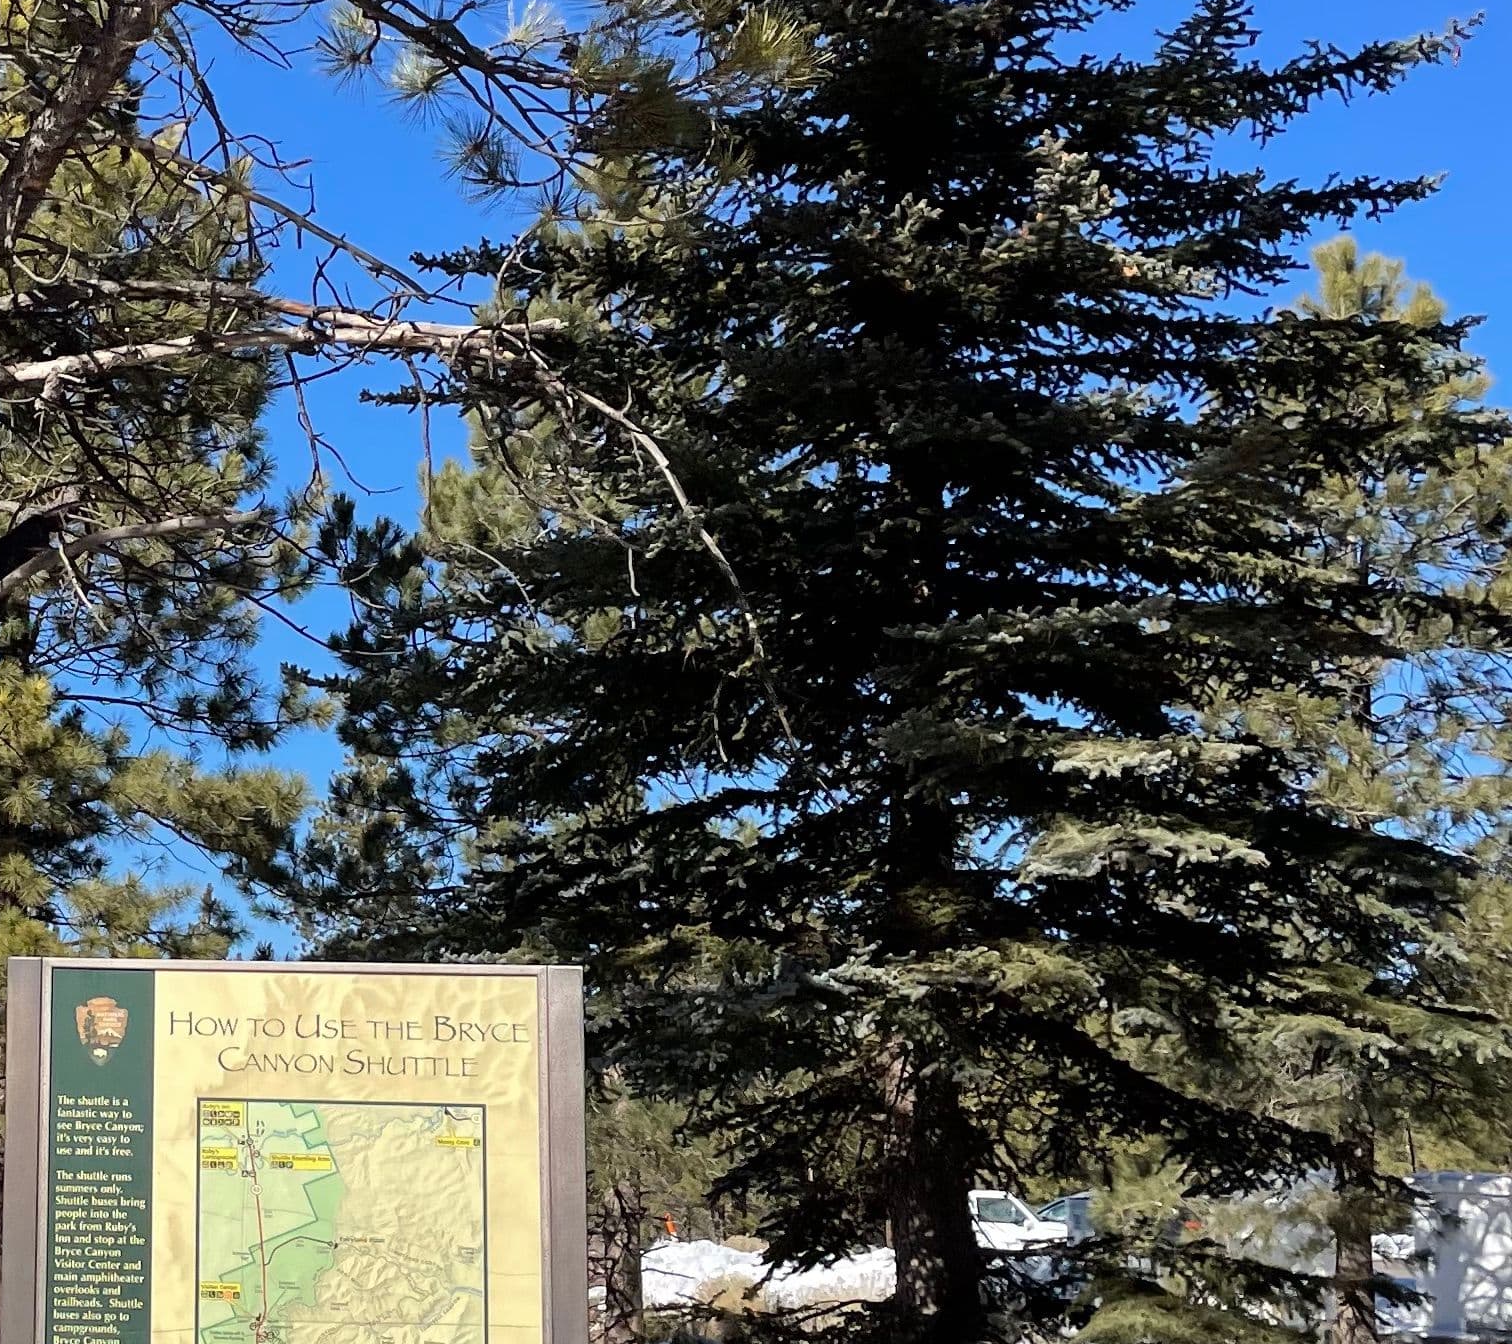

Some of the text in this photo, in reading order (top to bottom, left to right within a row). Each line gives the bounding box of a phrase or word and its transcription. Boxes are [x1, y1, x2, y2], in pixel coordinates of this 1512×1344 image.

[58, 1095, 75, 1105] The
[78, 1096, 109, 1106] shuttle
[112, 1097, 120, 1106] is
[57, 1108, 132, 1120] fantastic way to
[75, 1121, 102, 1133] Bryce
[56, 1133, 130, 1145] it's very easy to
[56, 1146, 133, 1156] use and it's free.
[56, 1170, 132, 1181] The shuttle runs
[56, 1184, 123, 1195] summers only.
[56, 1196, 146, 1209] Shuttle buses bring
[56, 1208, 127, 1220] people into the
[55, 1221, 136, 1234] park from Ruby's
[55, 1234, 145, 1246] Inn and stop at the
[55, 1246, 121, 1258] Bryce Canyon
[55, 1258, 141, 1270] Visitor Center and
[54, 1272, 144, 1284] main amphitheater
[54, 1284, 121, 1295] overlooks and
[54, 1297, 143, 1309] trailheads. Shuttle
[53, 1309, 129, 1323] buses also go to
[53, 1324, 120, 1335] campgrounds,
